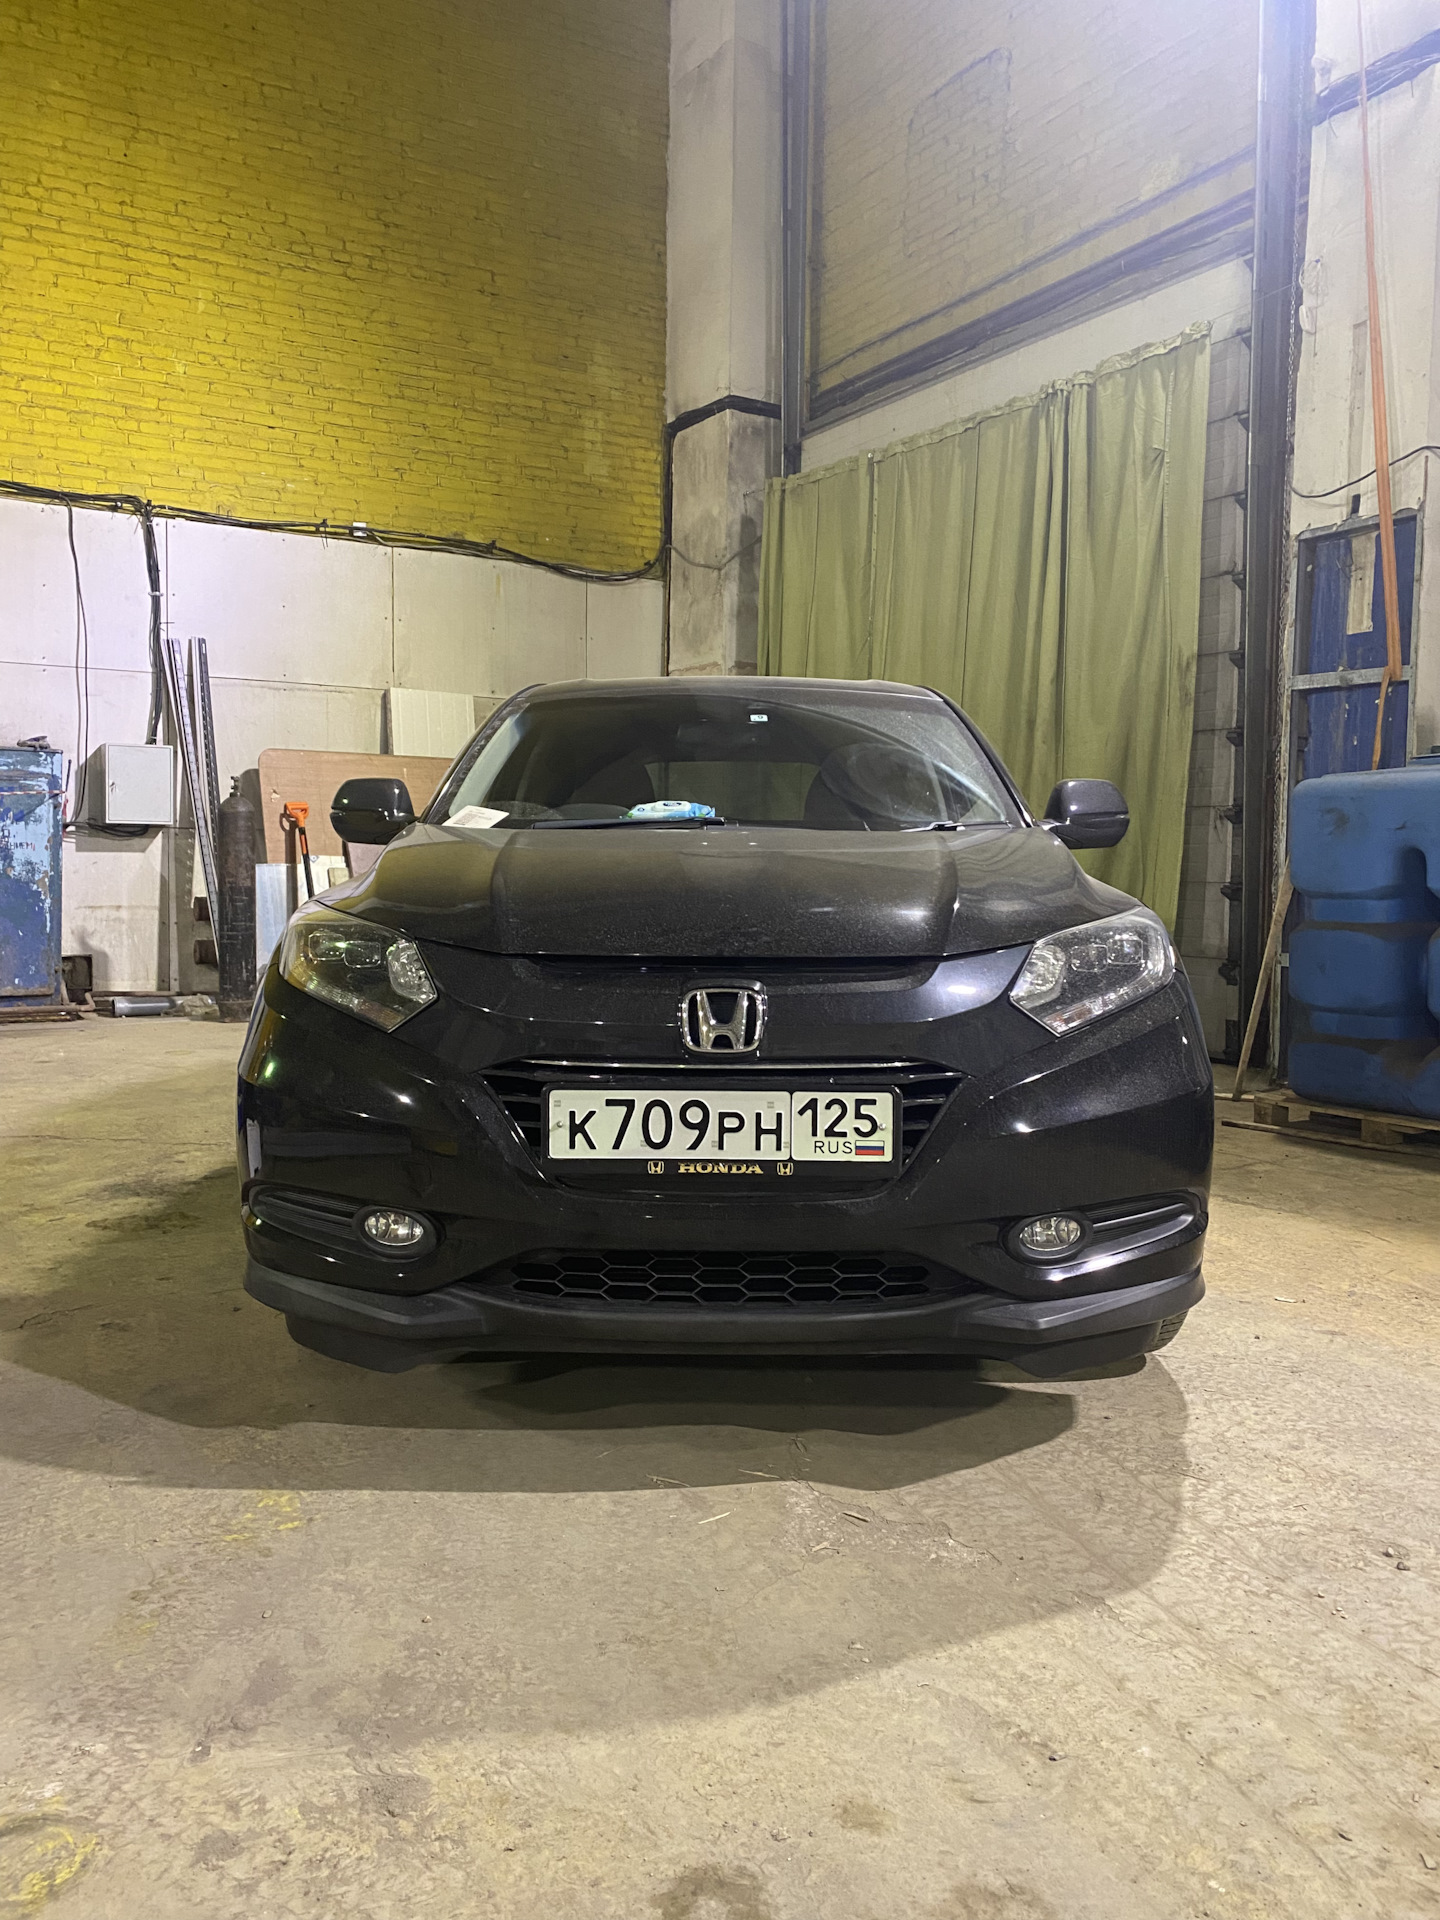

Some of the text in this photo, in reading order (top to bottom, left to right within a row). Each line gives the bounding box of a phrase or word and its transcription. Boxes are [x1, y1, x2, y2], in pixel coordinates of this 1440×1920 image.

[797, 1098, 878, 1138] 125
[814, 1141, 853, 1154] RUS
[678, 1162, 764, 1174] HONDA
